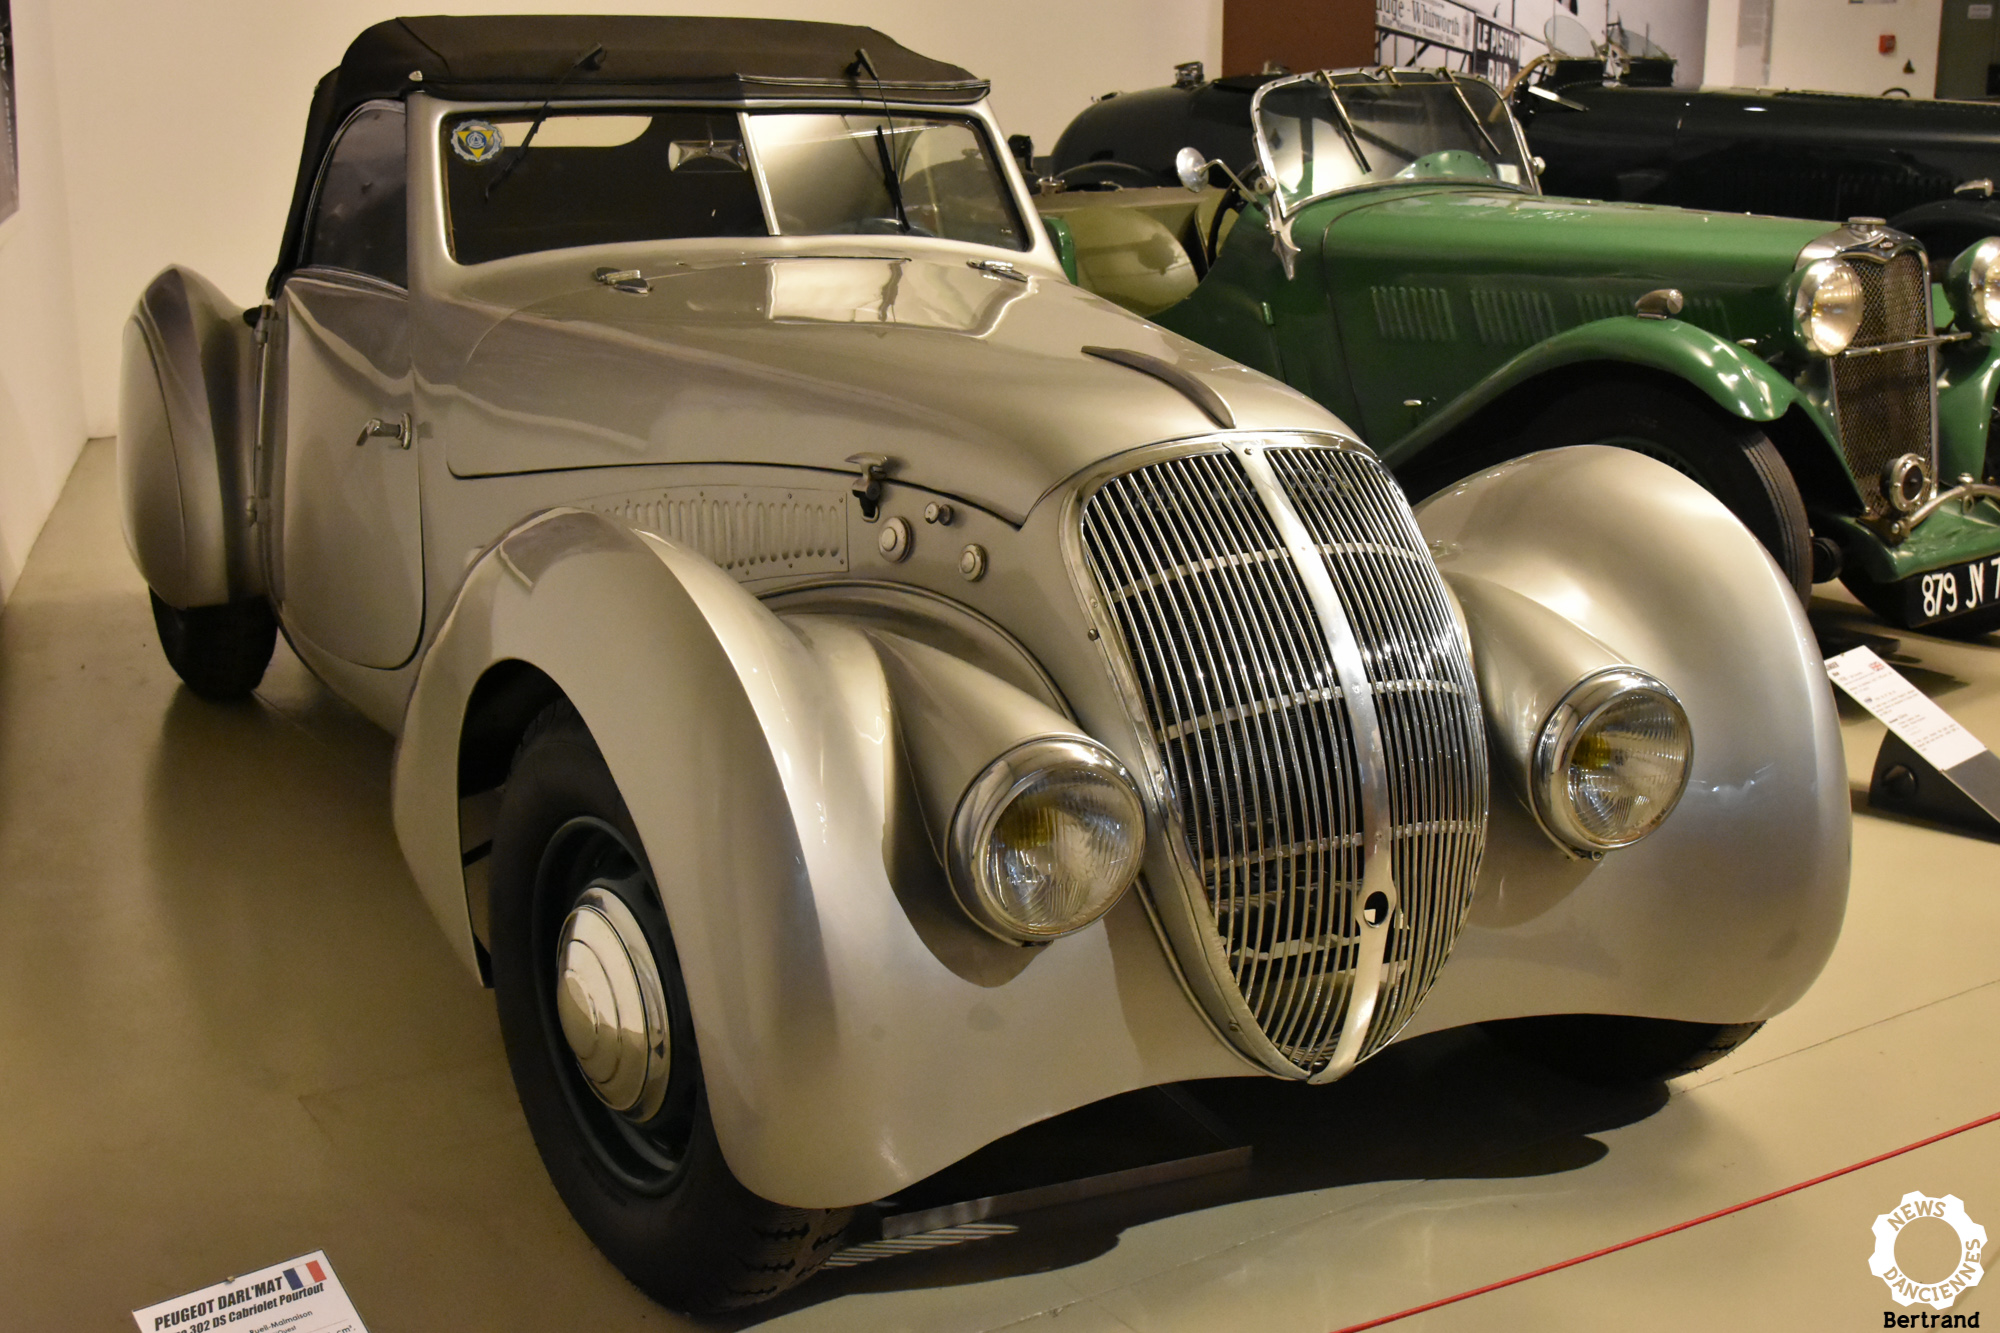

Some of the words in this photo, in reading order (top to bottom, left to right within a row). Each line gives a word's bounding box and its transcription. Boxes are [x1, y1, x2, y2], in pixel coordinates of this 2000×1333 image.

[1477, 22, 1489, 51] LE
[1922, 572, 1958, 617] 879
[155, 1299, 214, 1331] PEUGEOT
[218, 1276, 282, 1310] DARL'MAT
[190, 1320, 210, 1333] 302
[213, 1315, 226, 1328] DS
[229, 1298, 278, 1322] Cabriolet
[279, 1282, 324, 1306] Pourtout
